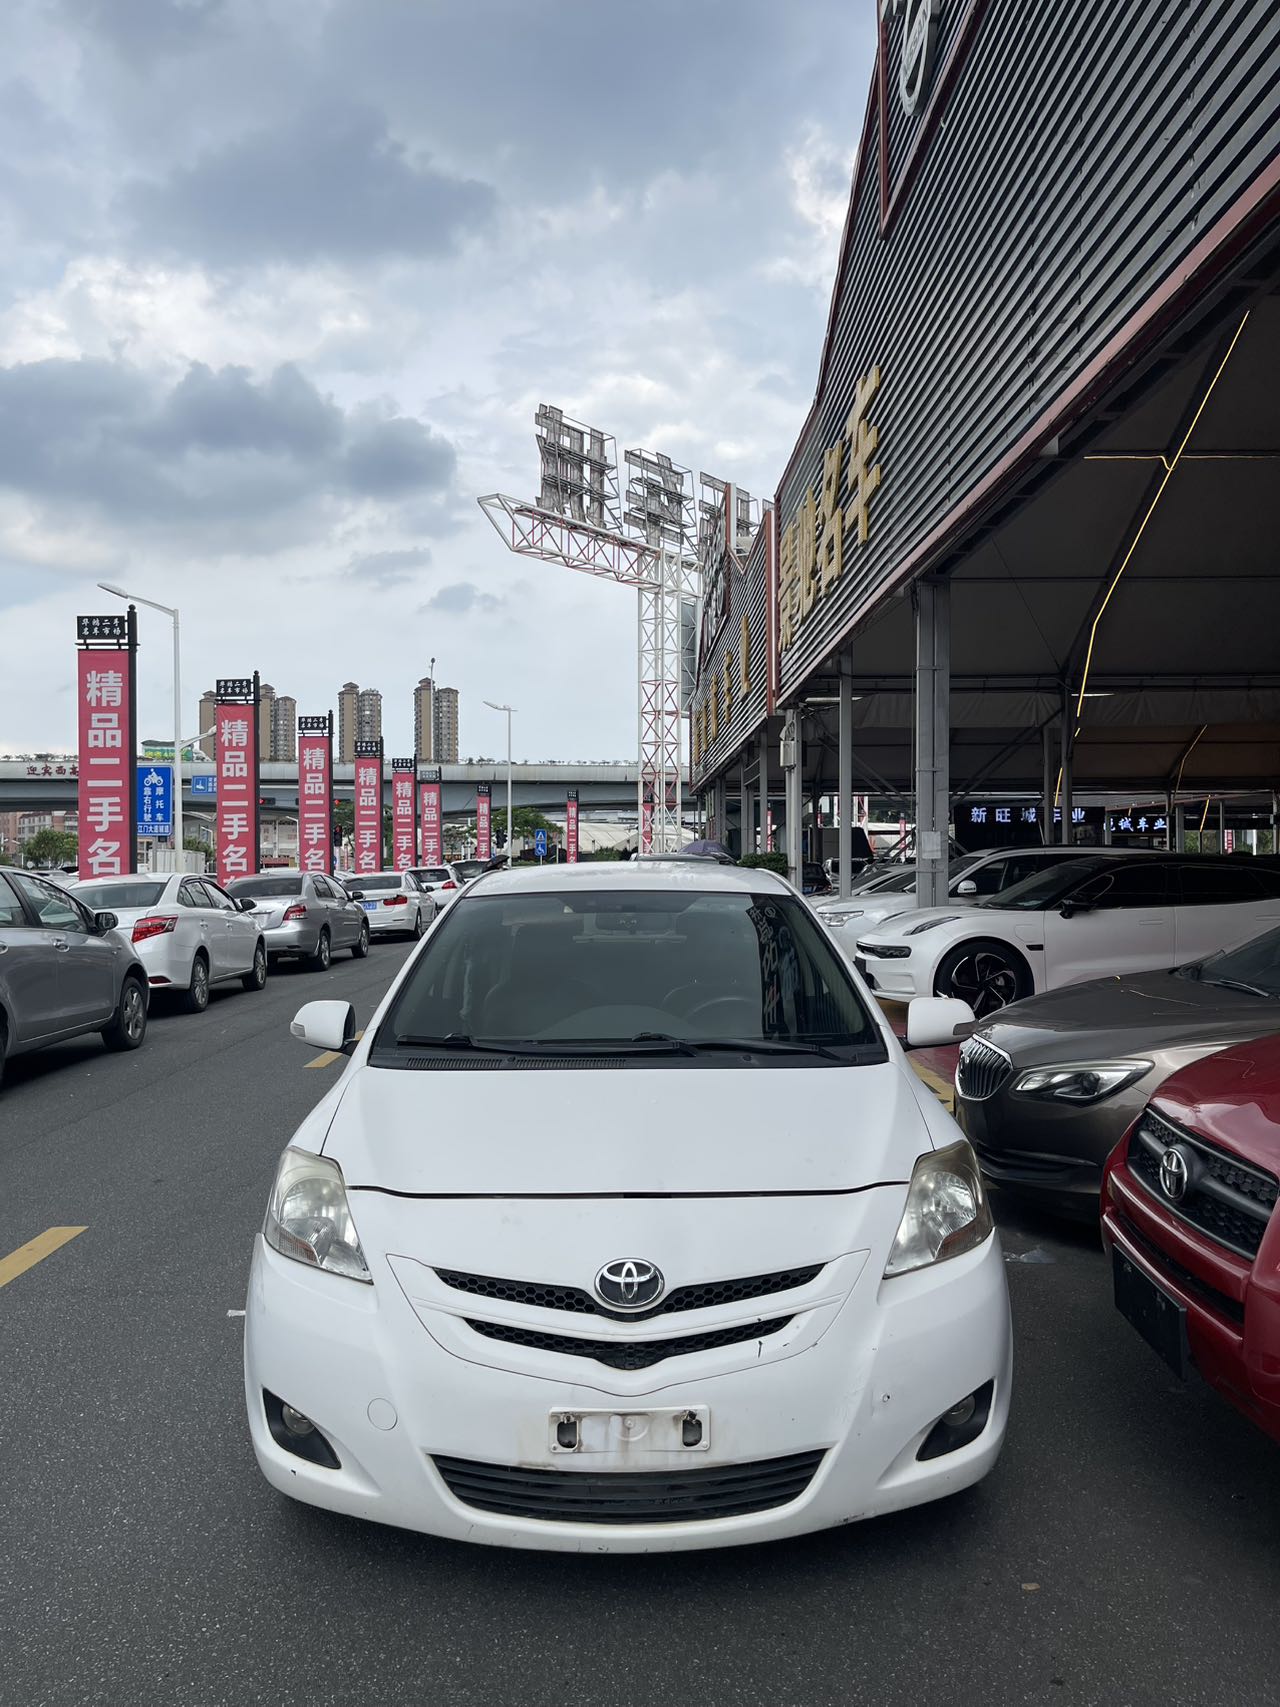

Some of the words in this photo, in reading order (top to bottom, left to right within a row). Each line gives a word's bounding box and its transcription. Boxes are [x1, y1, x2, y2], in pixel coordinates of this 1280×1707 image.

[221, 720, 249, 884] 精品二手名
